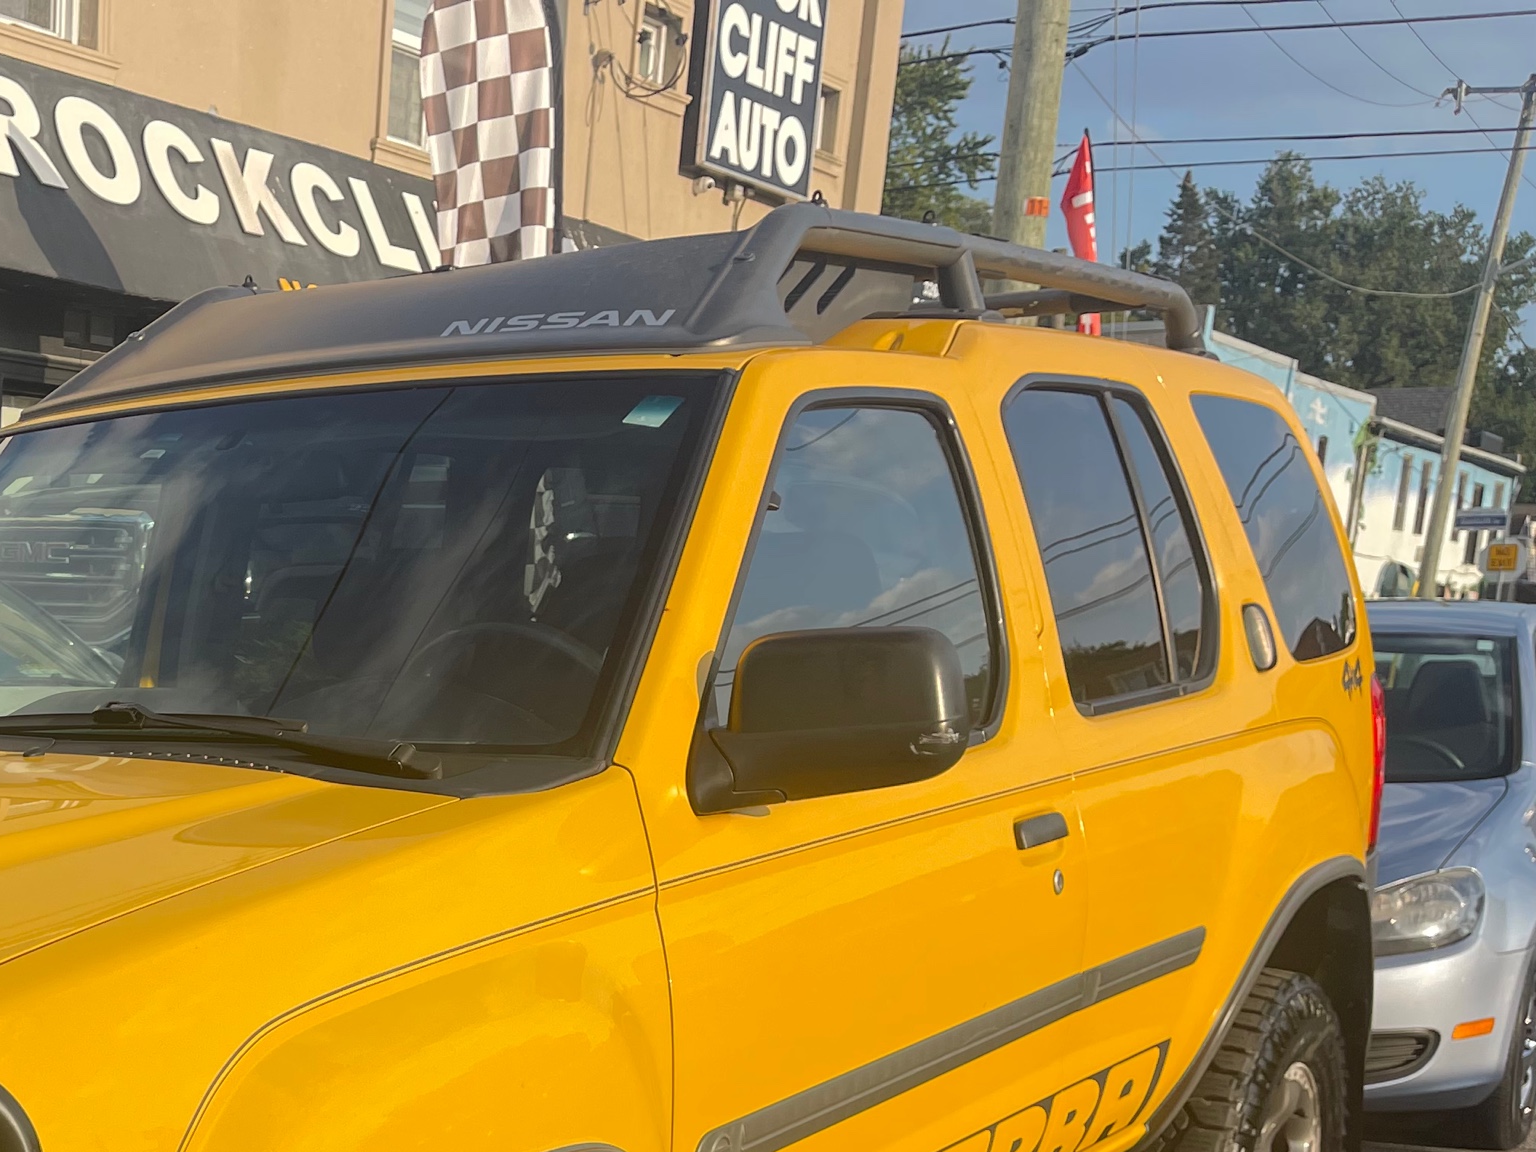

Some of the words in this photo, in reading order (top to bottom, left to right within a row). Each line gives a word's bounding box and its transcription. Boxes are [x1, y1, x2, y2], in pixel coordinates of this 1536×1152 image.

[719, 3, 817, 105] CLIFF
[709, 90, 807, 187] AUTO
[440, 309, 676, 338] NISSAN
